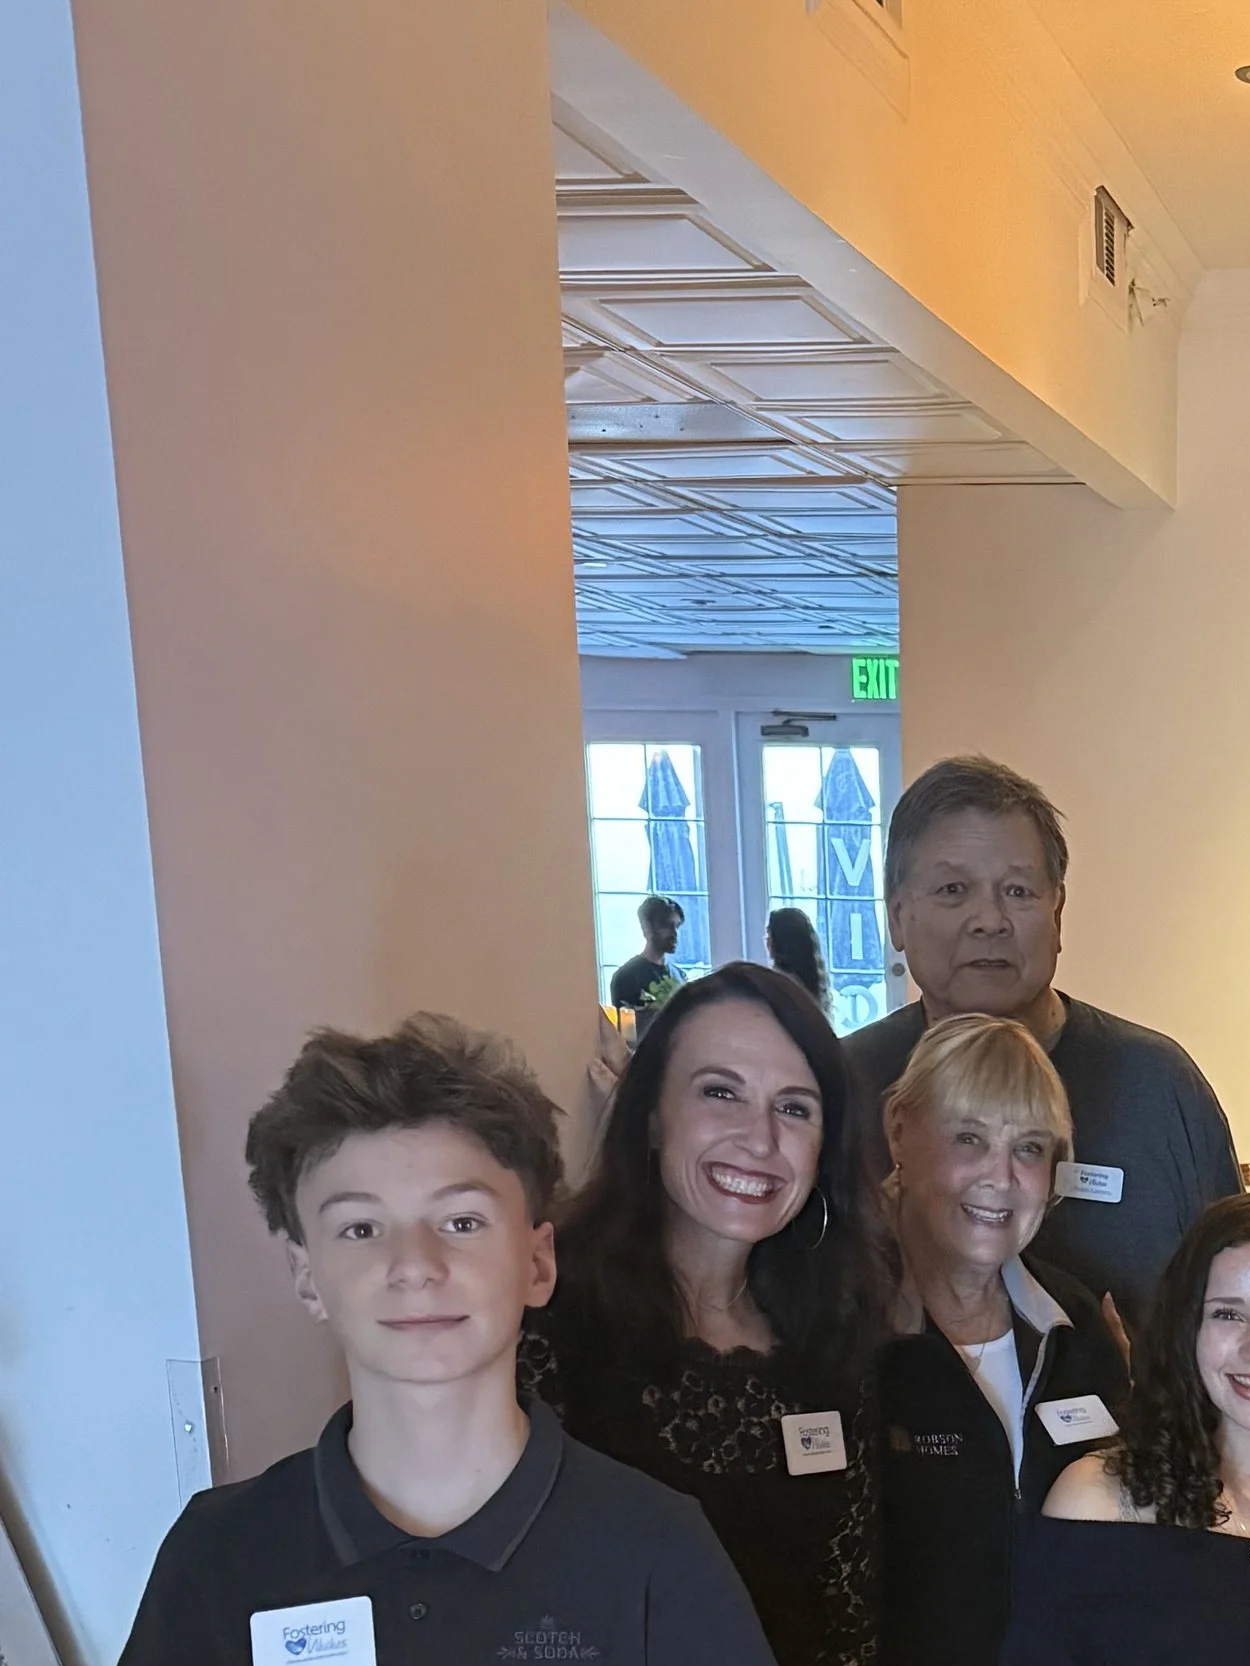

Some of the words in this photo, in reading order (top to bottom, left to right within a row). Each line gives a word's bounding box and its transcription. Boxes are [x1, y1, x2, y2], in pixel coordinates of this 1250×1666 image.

[852, 658, 900, 700] EXIT
[282, 1619, 346, 1640] Fostering
[513, 1631, 581, 1645] SCOTCH
[533, 1646, 580, 1660] SODA
